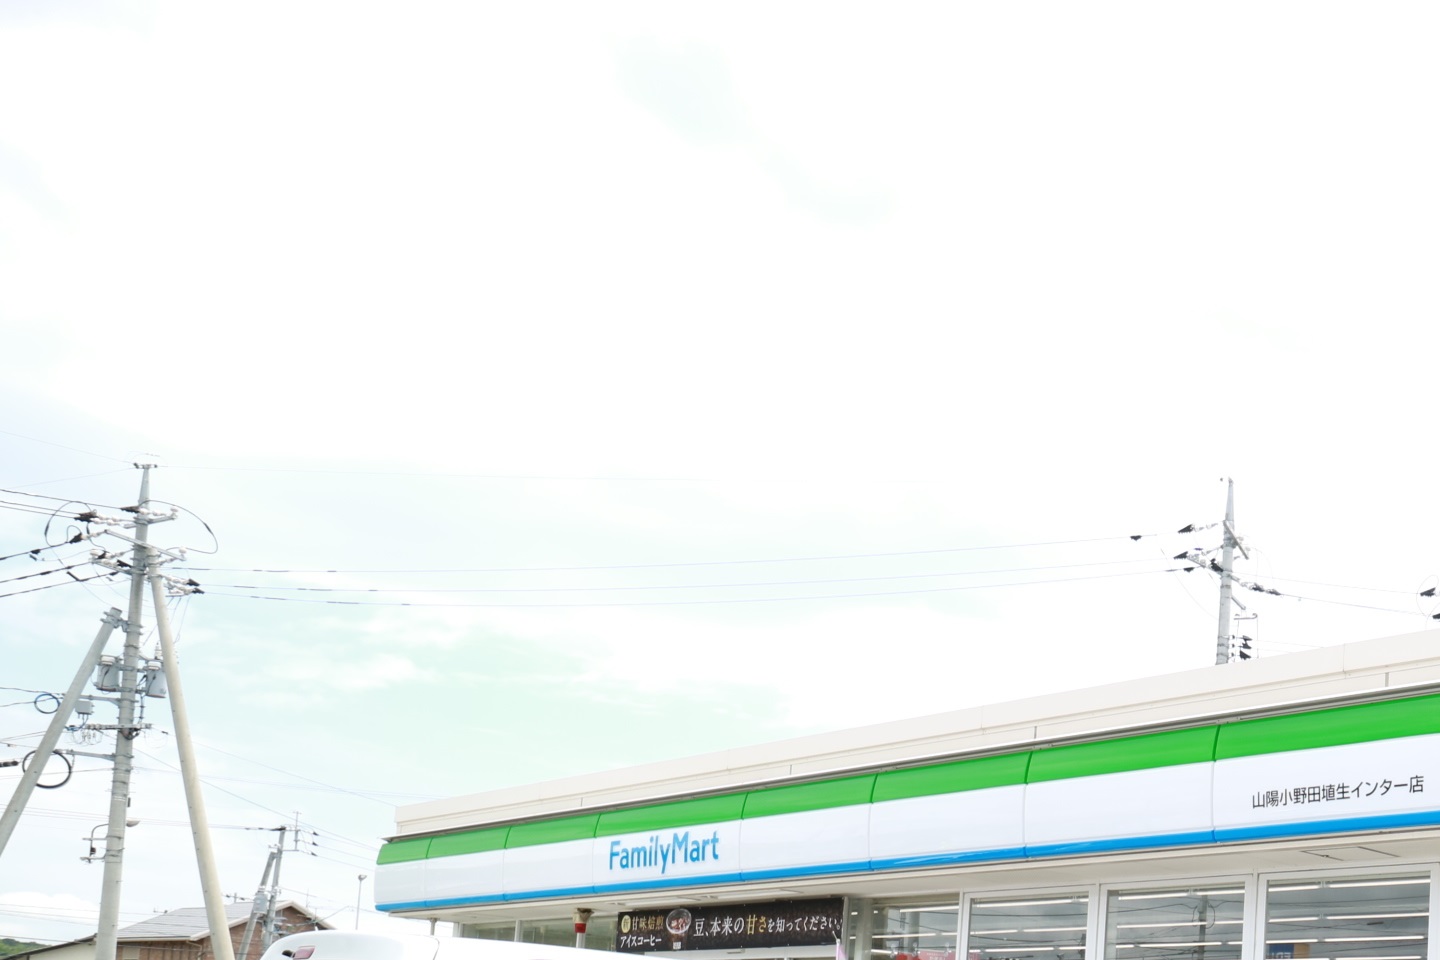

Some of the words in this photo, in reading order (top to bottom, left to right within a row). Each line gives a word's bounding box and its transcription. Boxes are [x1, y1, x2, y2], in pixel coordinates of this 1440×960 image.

[1252, 775, 1424, 809] 山陽小野田埴生インター店
[609, 830, 720, 874] FamilyMart
[620, 935, 662, 948] アイスコーヒー
